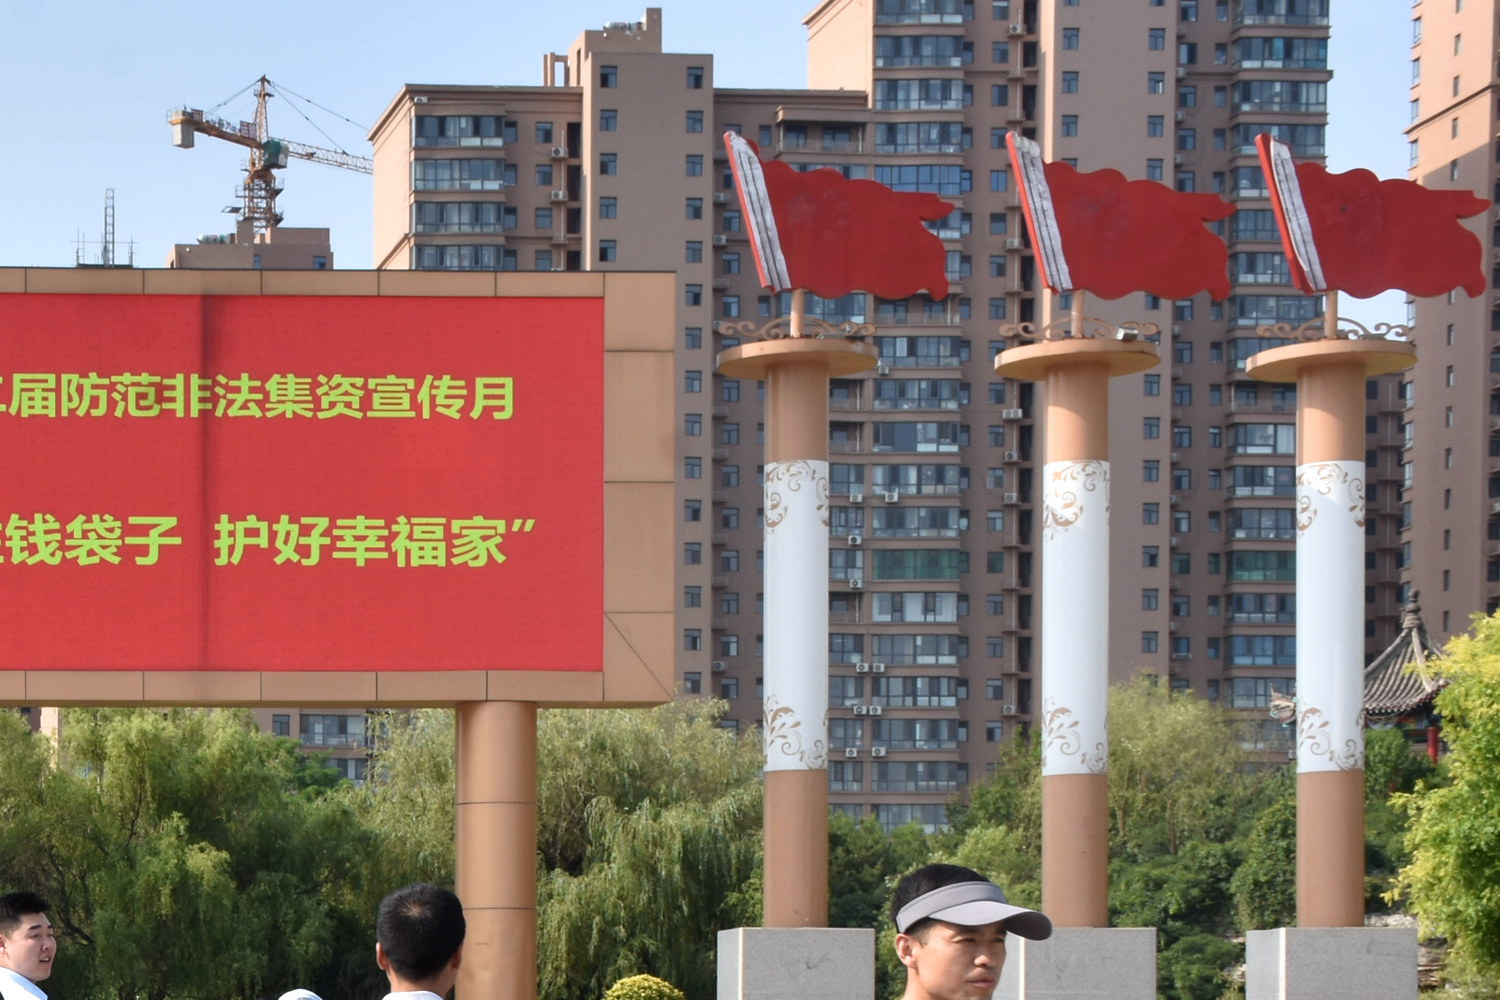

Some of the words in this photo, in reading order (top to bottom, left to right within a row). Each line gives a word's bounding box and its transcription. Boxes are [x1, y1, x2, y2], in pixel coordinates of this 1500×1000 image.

[213, 514, 536, 567] 护好幸福家”
